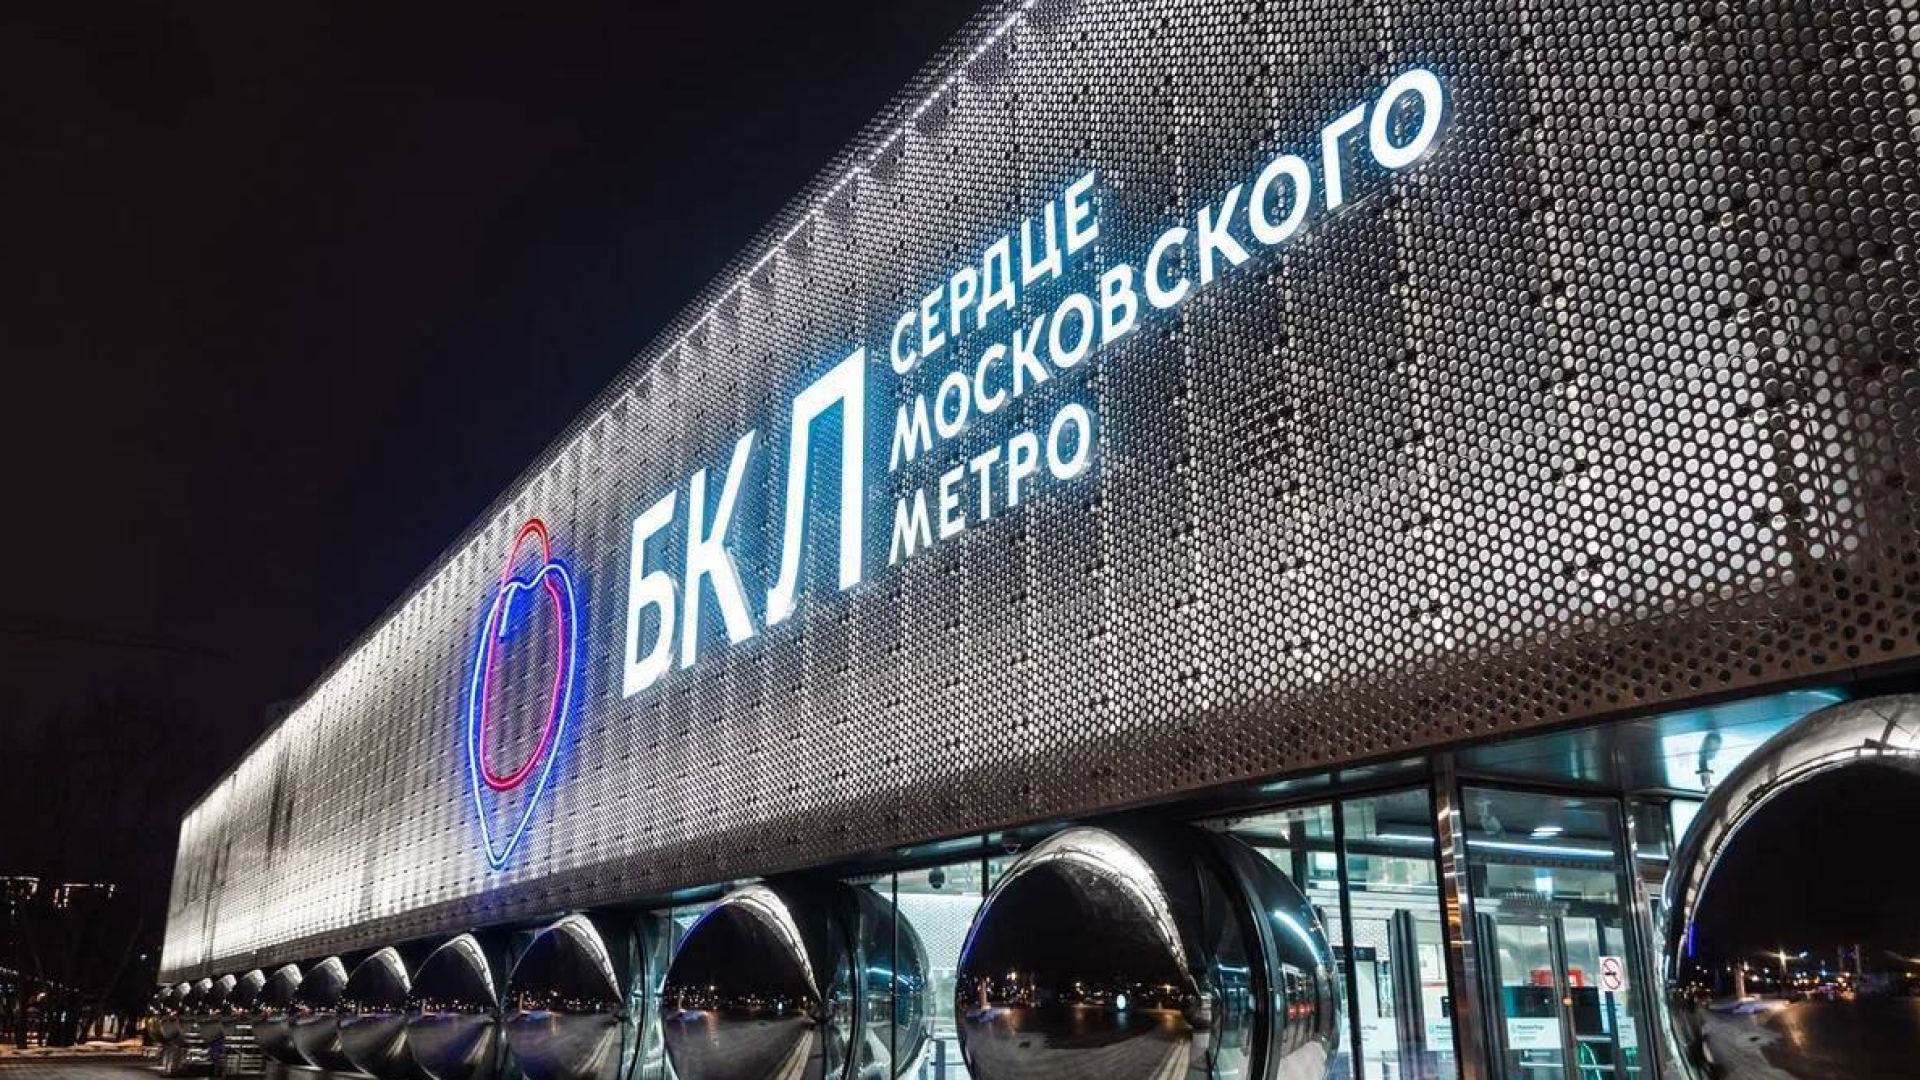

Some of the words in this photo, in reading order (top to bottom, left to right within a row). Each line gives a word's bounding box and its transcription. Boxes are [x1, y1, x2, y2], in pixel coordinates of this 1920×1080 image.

[888, 68, 1443, 471] МОСКОВСКОГО
[891, 169, 1101, 375] СЕРДЦЕ
[623, 347, 866, 699] БКЛ
[888, 403, 1092, 566] МЕТРО
